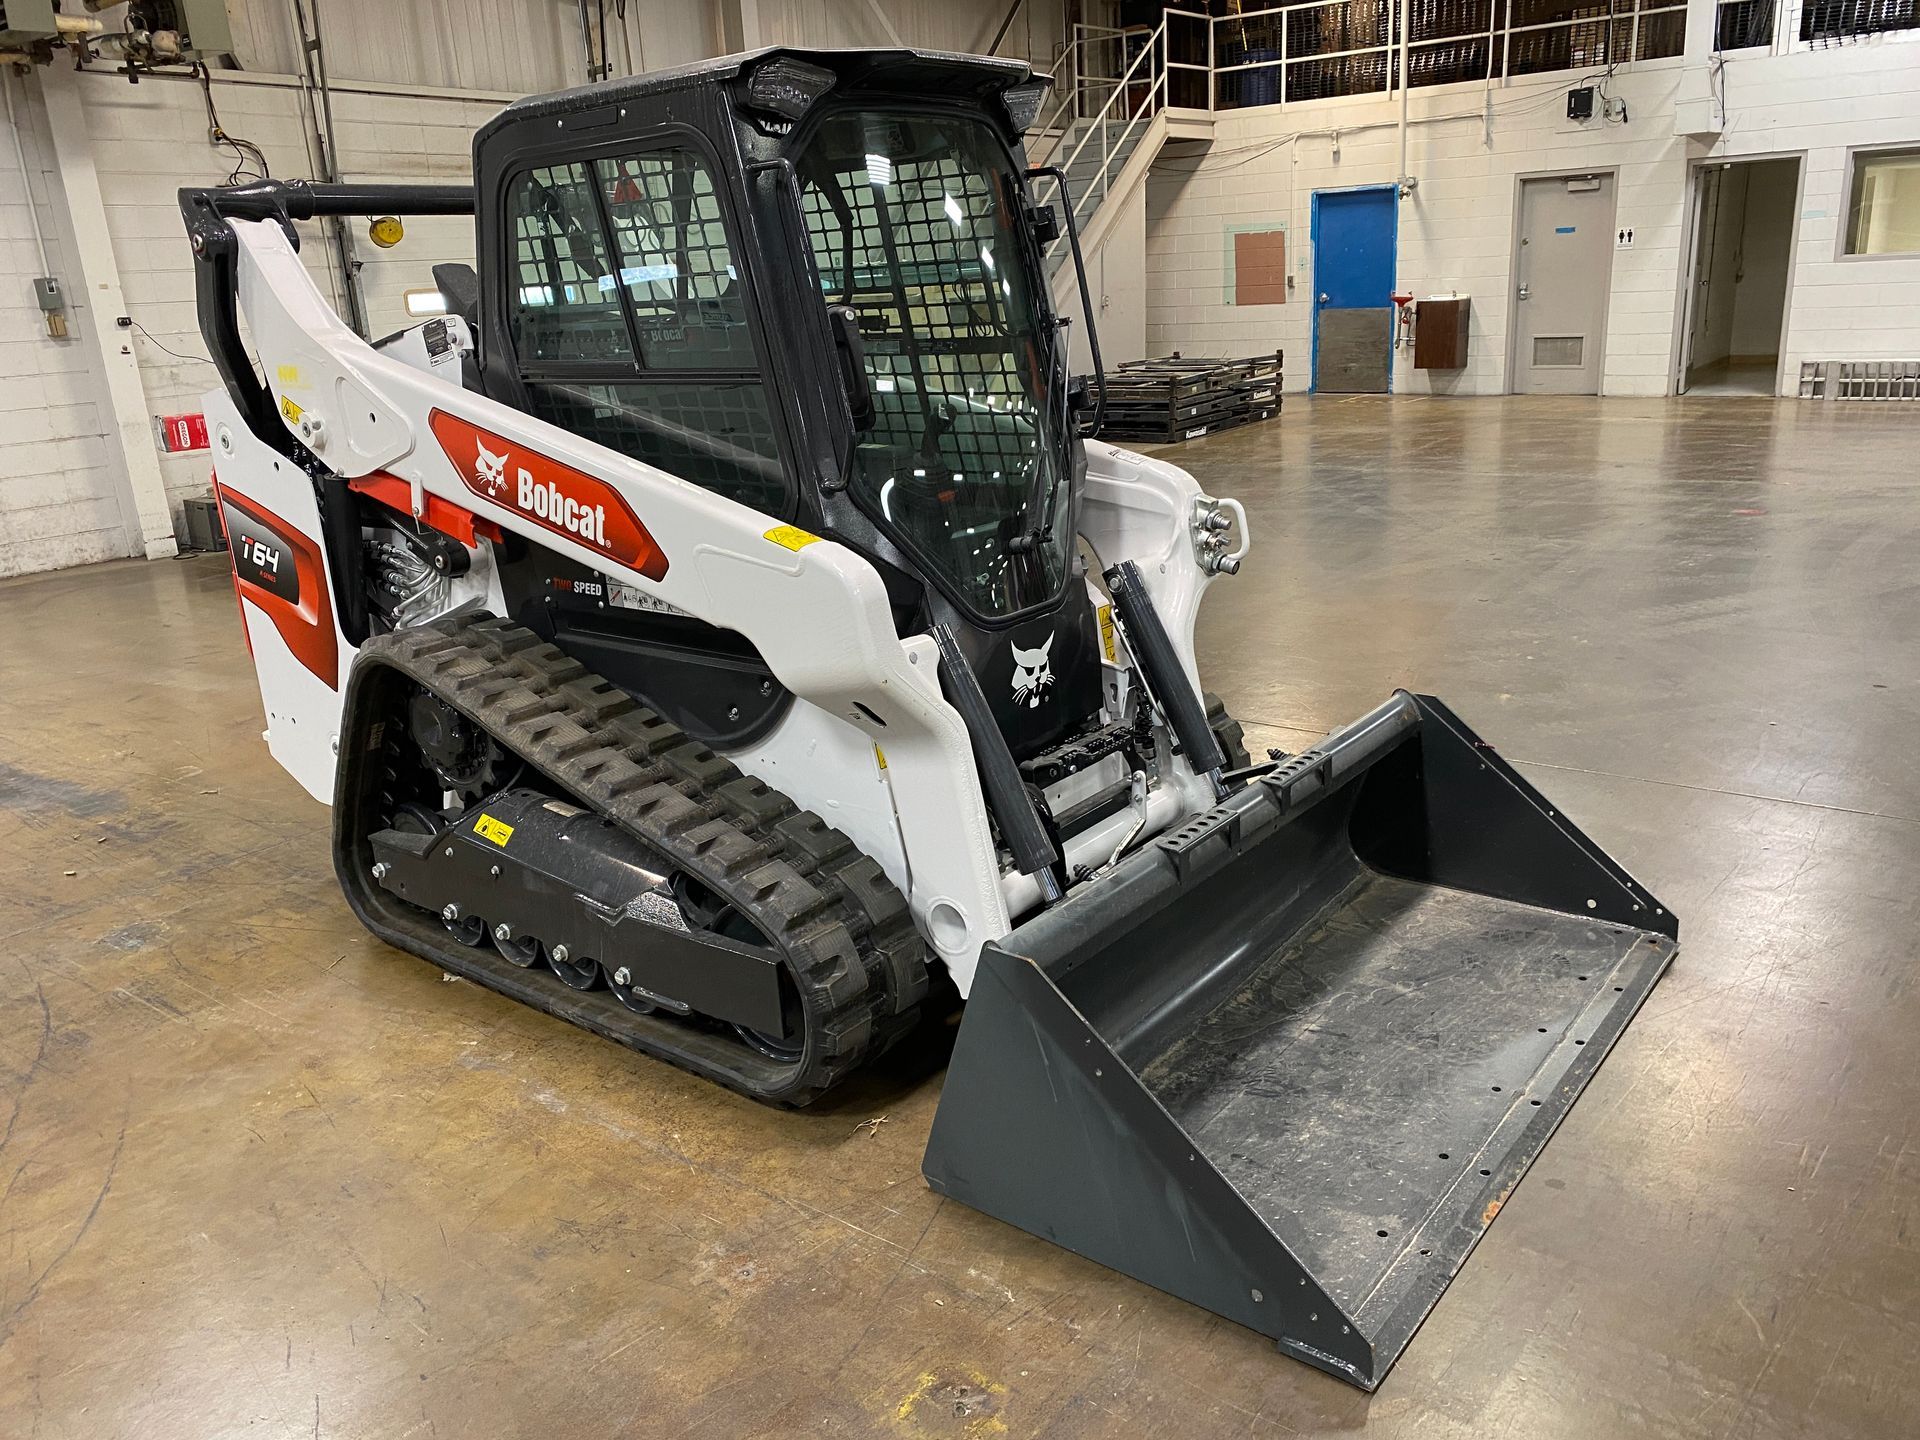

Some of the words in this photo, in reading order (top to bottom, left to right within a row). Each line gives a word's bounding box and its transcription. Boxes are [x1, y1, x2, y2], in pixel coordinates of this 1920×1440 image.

[180, 422, 189, 446] OREGON
[518, 468, 605, 546] Bobcat
[241, 535, 279, 573] T64
[553, 577, 572, 591] TWO
[573, 581, 602, 596] SPEED
